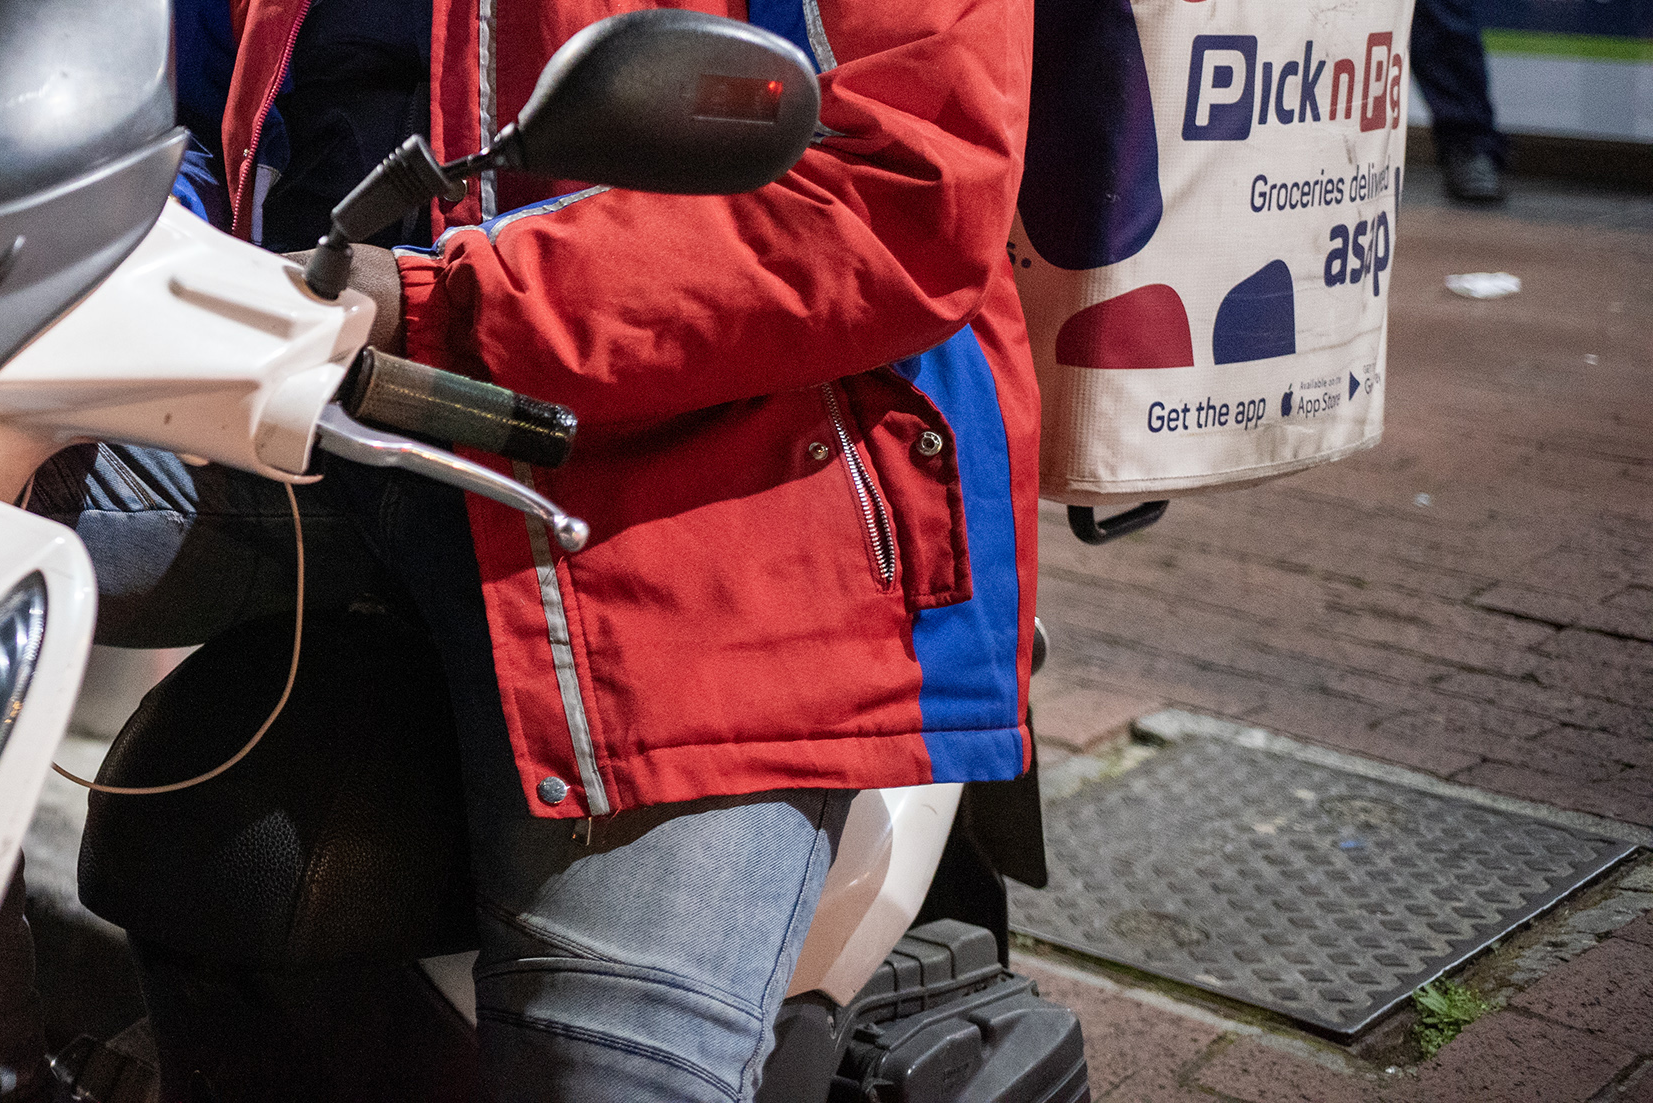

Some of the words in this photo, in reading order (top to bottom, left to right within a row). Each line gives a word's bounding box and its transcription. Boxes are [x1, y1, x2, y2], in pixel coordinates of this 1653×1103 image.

[1182, 35, 1327, 141] Pick
[1250, 168, 1345, 214] Groceries
[1147, 401, 1190, 434] Get
[1195, 397, 1231, 430] the
[1234, 395, 1267, 432] app
[1296, 395, 1321, 419] App
[1322, 391, 1342, 412] Store
